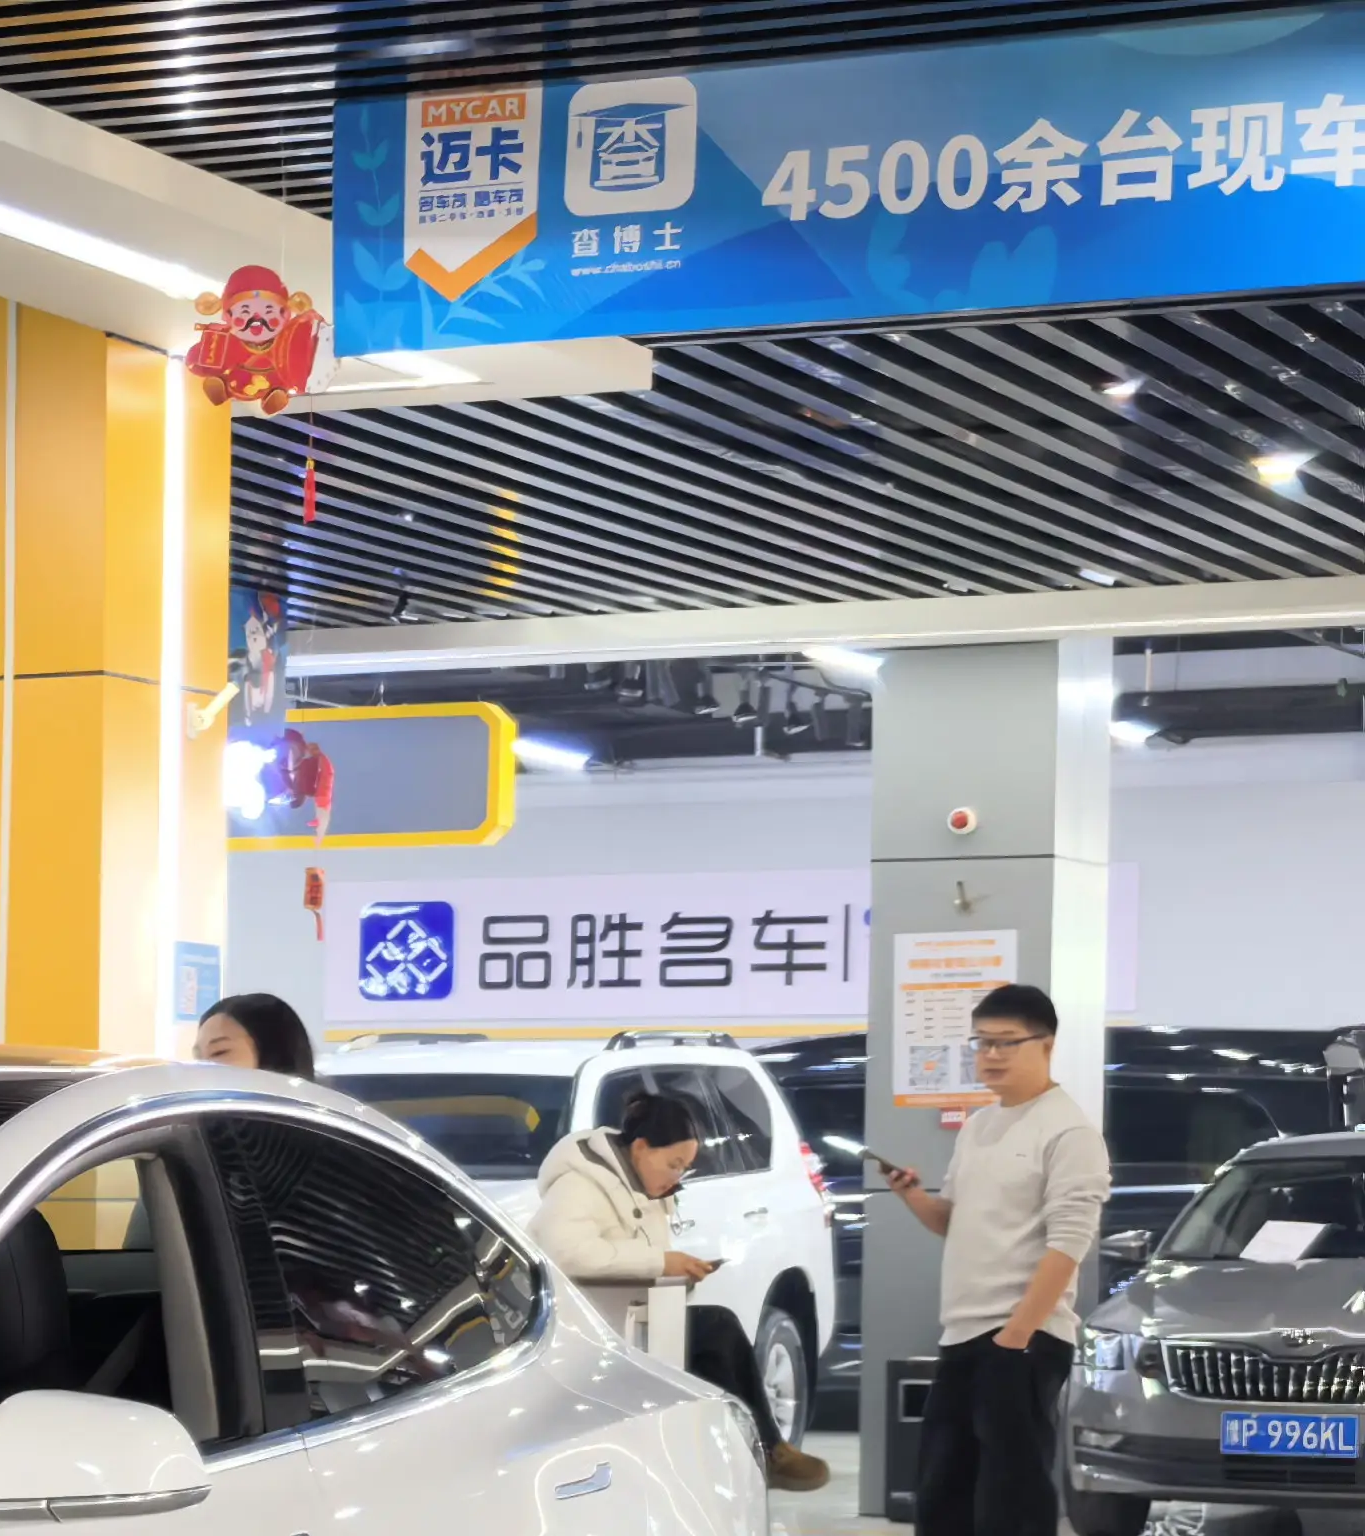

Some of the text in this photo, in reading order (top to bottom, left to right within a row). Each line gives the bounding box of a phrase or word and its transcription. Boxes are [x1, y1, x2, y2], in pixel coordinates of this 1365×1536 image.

[427, 97, 520, 123] MYCAR
[420, 127, 524, 186] 迈卡
[762, 93, 1365, 222] 4500余台现车
[571, 221, 684, 258] 查博士
[479, 909, 829, 990] 品胜名车
